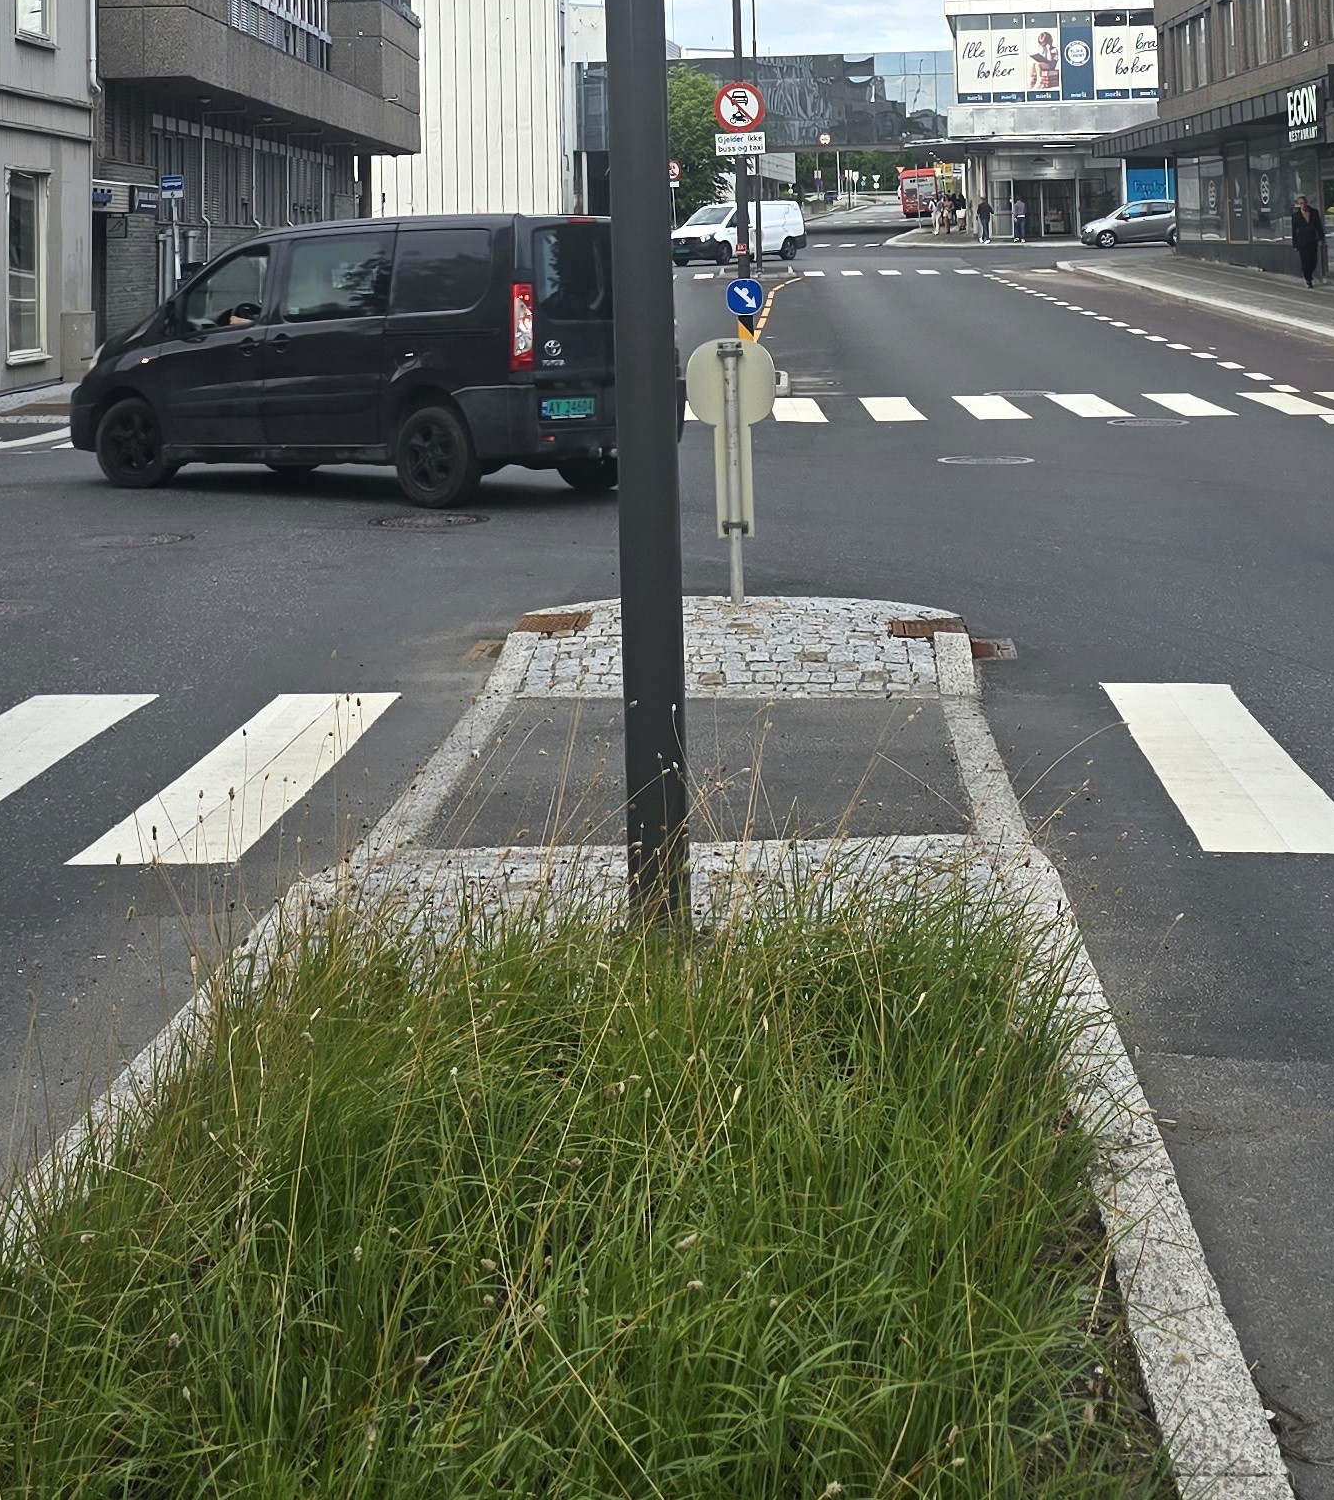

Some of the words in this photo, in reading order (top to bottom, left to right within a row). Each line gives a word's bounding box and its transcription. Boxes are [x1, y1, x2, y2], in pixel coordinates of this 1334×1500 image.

[996, 36, 1020, 55] bra
[1135, 32, 1158, 51] bra
[1287, 84, 1317, 127] EGON
[1288, 126, 1318, 143] RESTAURANT
